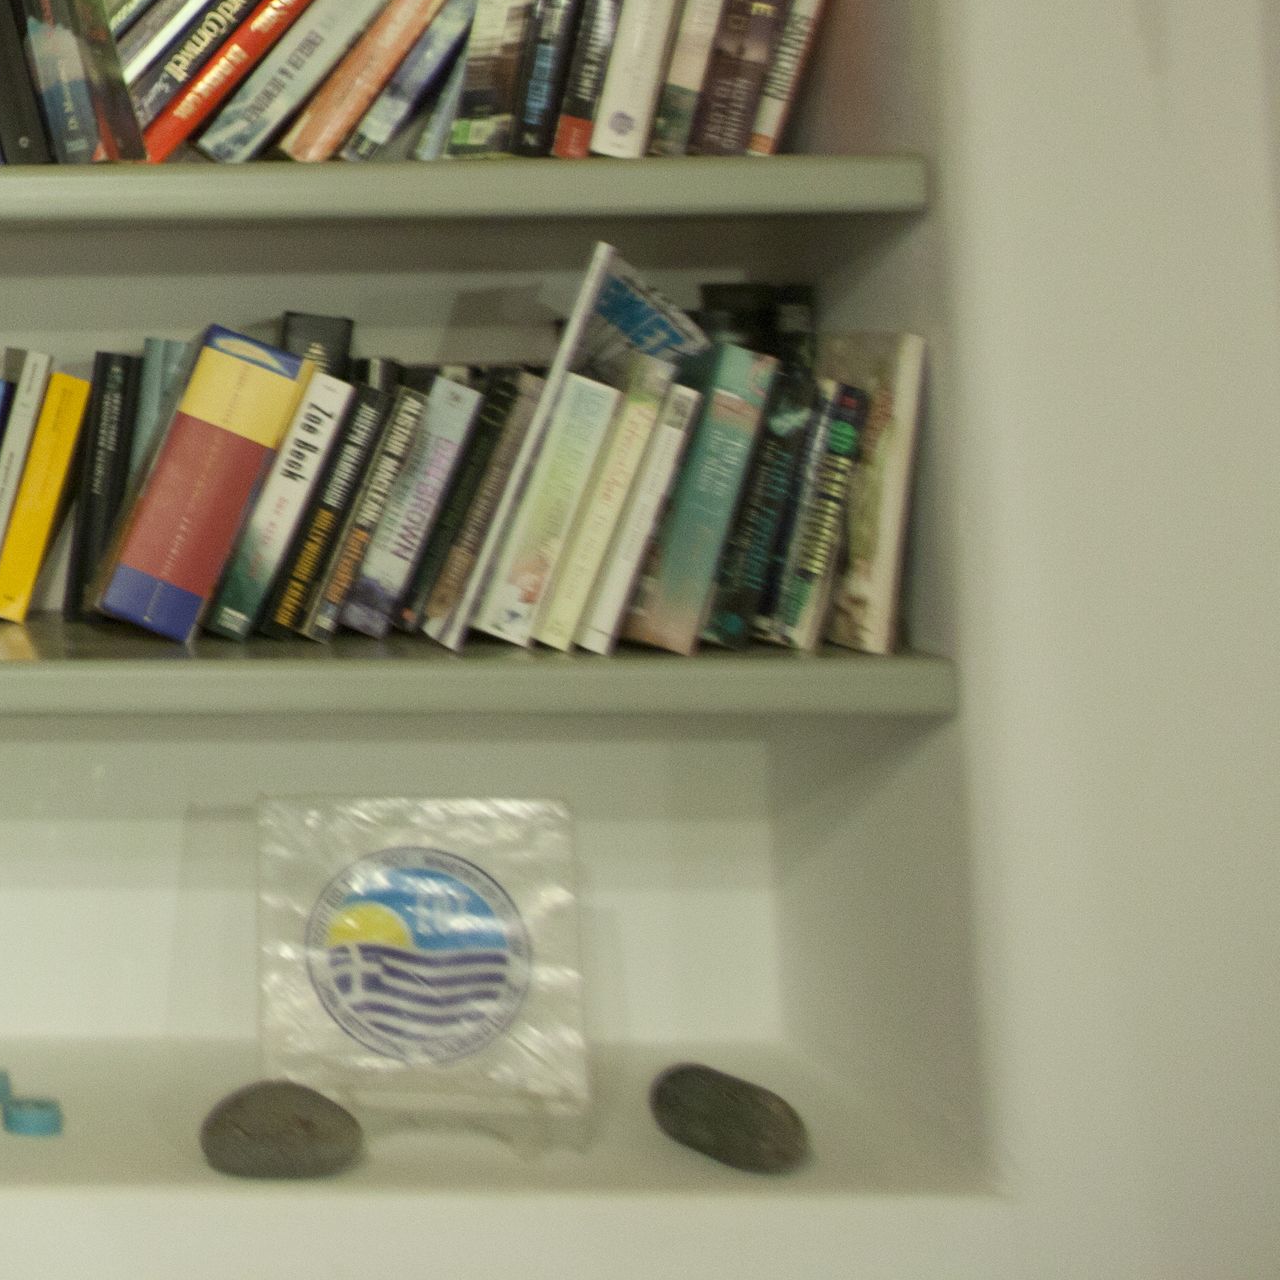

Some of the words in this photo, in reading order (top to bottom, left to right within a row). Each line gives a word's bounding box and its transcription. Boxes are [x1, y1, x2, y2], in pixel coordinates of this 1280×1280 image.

[161, 7, 232, 85] Cornwell
[345, 402, 381, 448] JOSEPH
[381, 393, 426, 459] ALISTAIR
[279, 436, 322, 486] Beck
[320, 441, 366, 511] WAMBAUGH
[421, 435, 459, 483] DAN
[388, 479, 441, 564] BROWN
